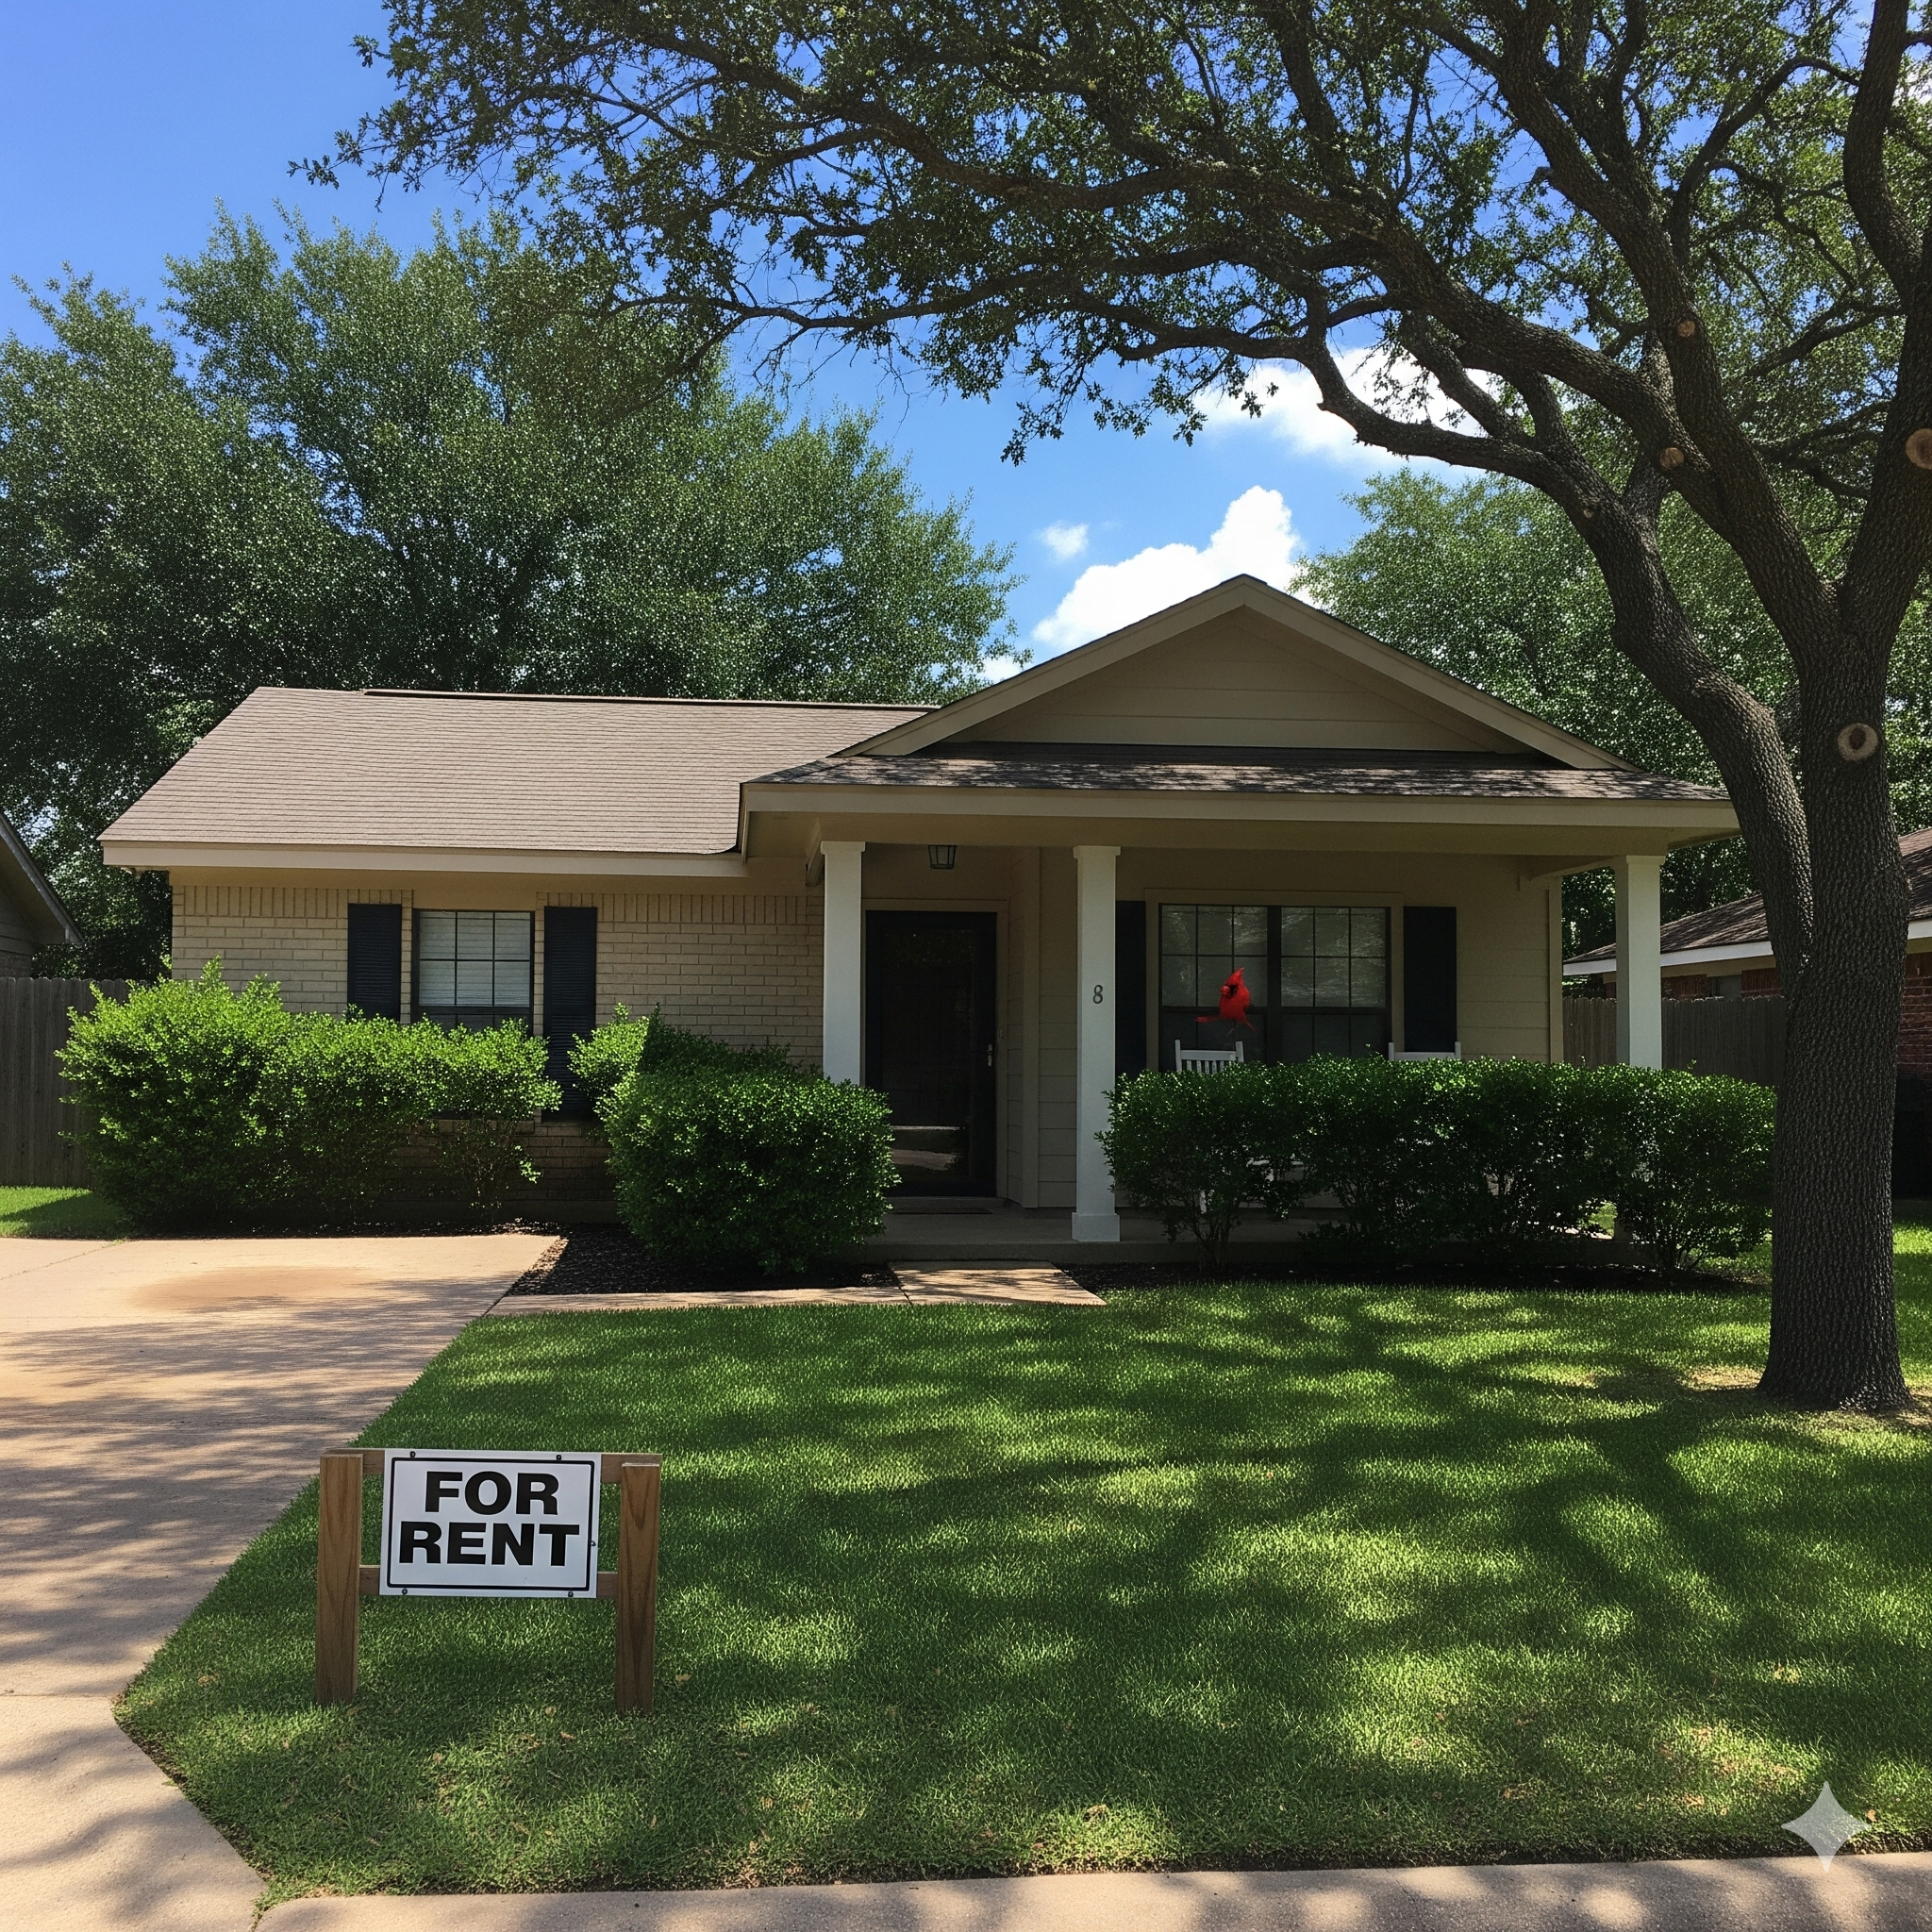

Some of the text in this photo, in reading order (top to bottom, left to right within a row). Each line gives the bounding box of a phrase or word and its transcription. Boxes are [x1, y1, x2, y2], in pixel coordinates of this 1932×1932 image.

[1092, 984, 1104, 1005] 8
[425, 1470, 560, 1516] FOR
[398, 1520, 580, 1567] RENT
